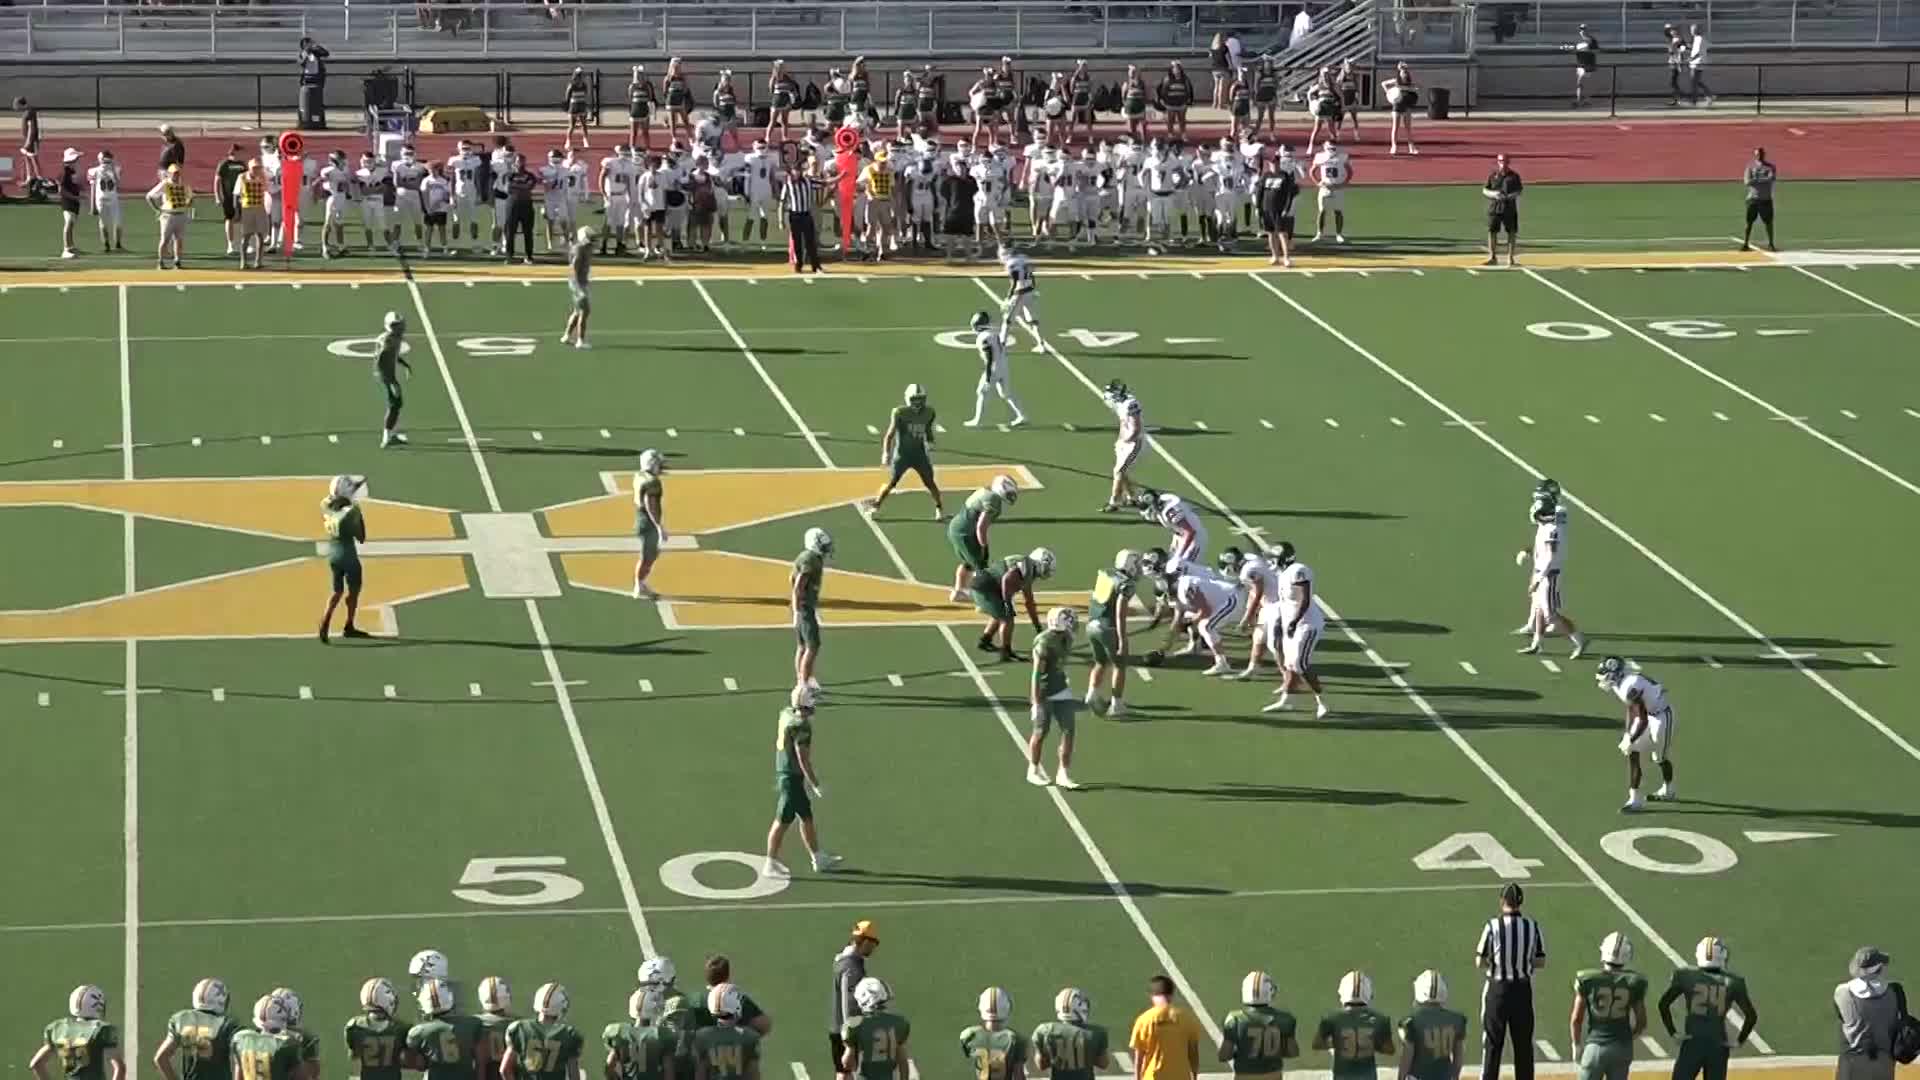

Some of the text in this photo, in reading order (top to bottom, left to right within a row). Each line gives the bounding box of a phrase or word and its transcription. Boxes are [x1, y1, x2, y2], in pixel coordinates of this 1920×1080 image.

[1597, 986, 1629, 1018] 32
[1691, 984, 1727, 1016] 24
[871, 1028, 897, 1062] 21
[1247, 1026, 1281, 1058] 70
[1423, 1024, 1456, 1058] 40
